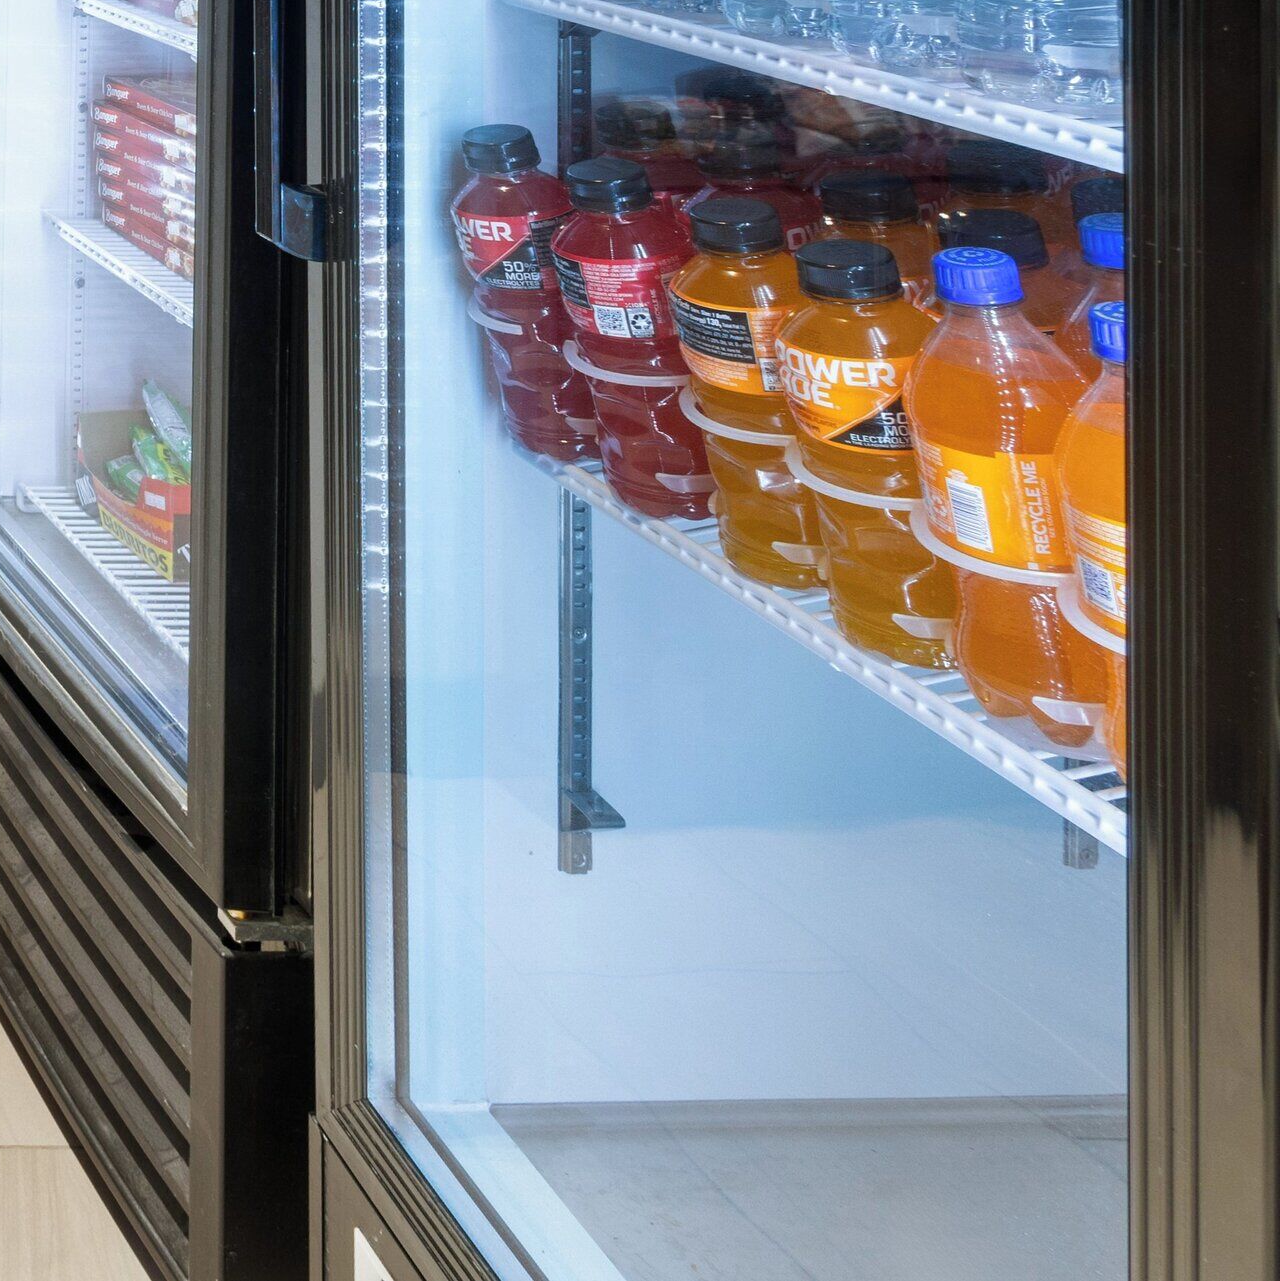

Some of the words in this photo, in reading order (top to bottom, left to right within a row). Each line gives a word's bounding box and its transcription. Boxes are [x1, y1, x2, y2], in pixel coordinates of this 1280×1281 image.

[502, 261, 537, 273] 50%
[775, 337, 898, 388] POWER
[1020, 460, 1037, 485] ME
[102, 508, 170, 574] BURRITOS
[1025, 488, 1051, 555] RECYCLE
